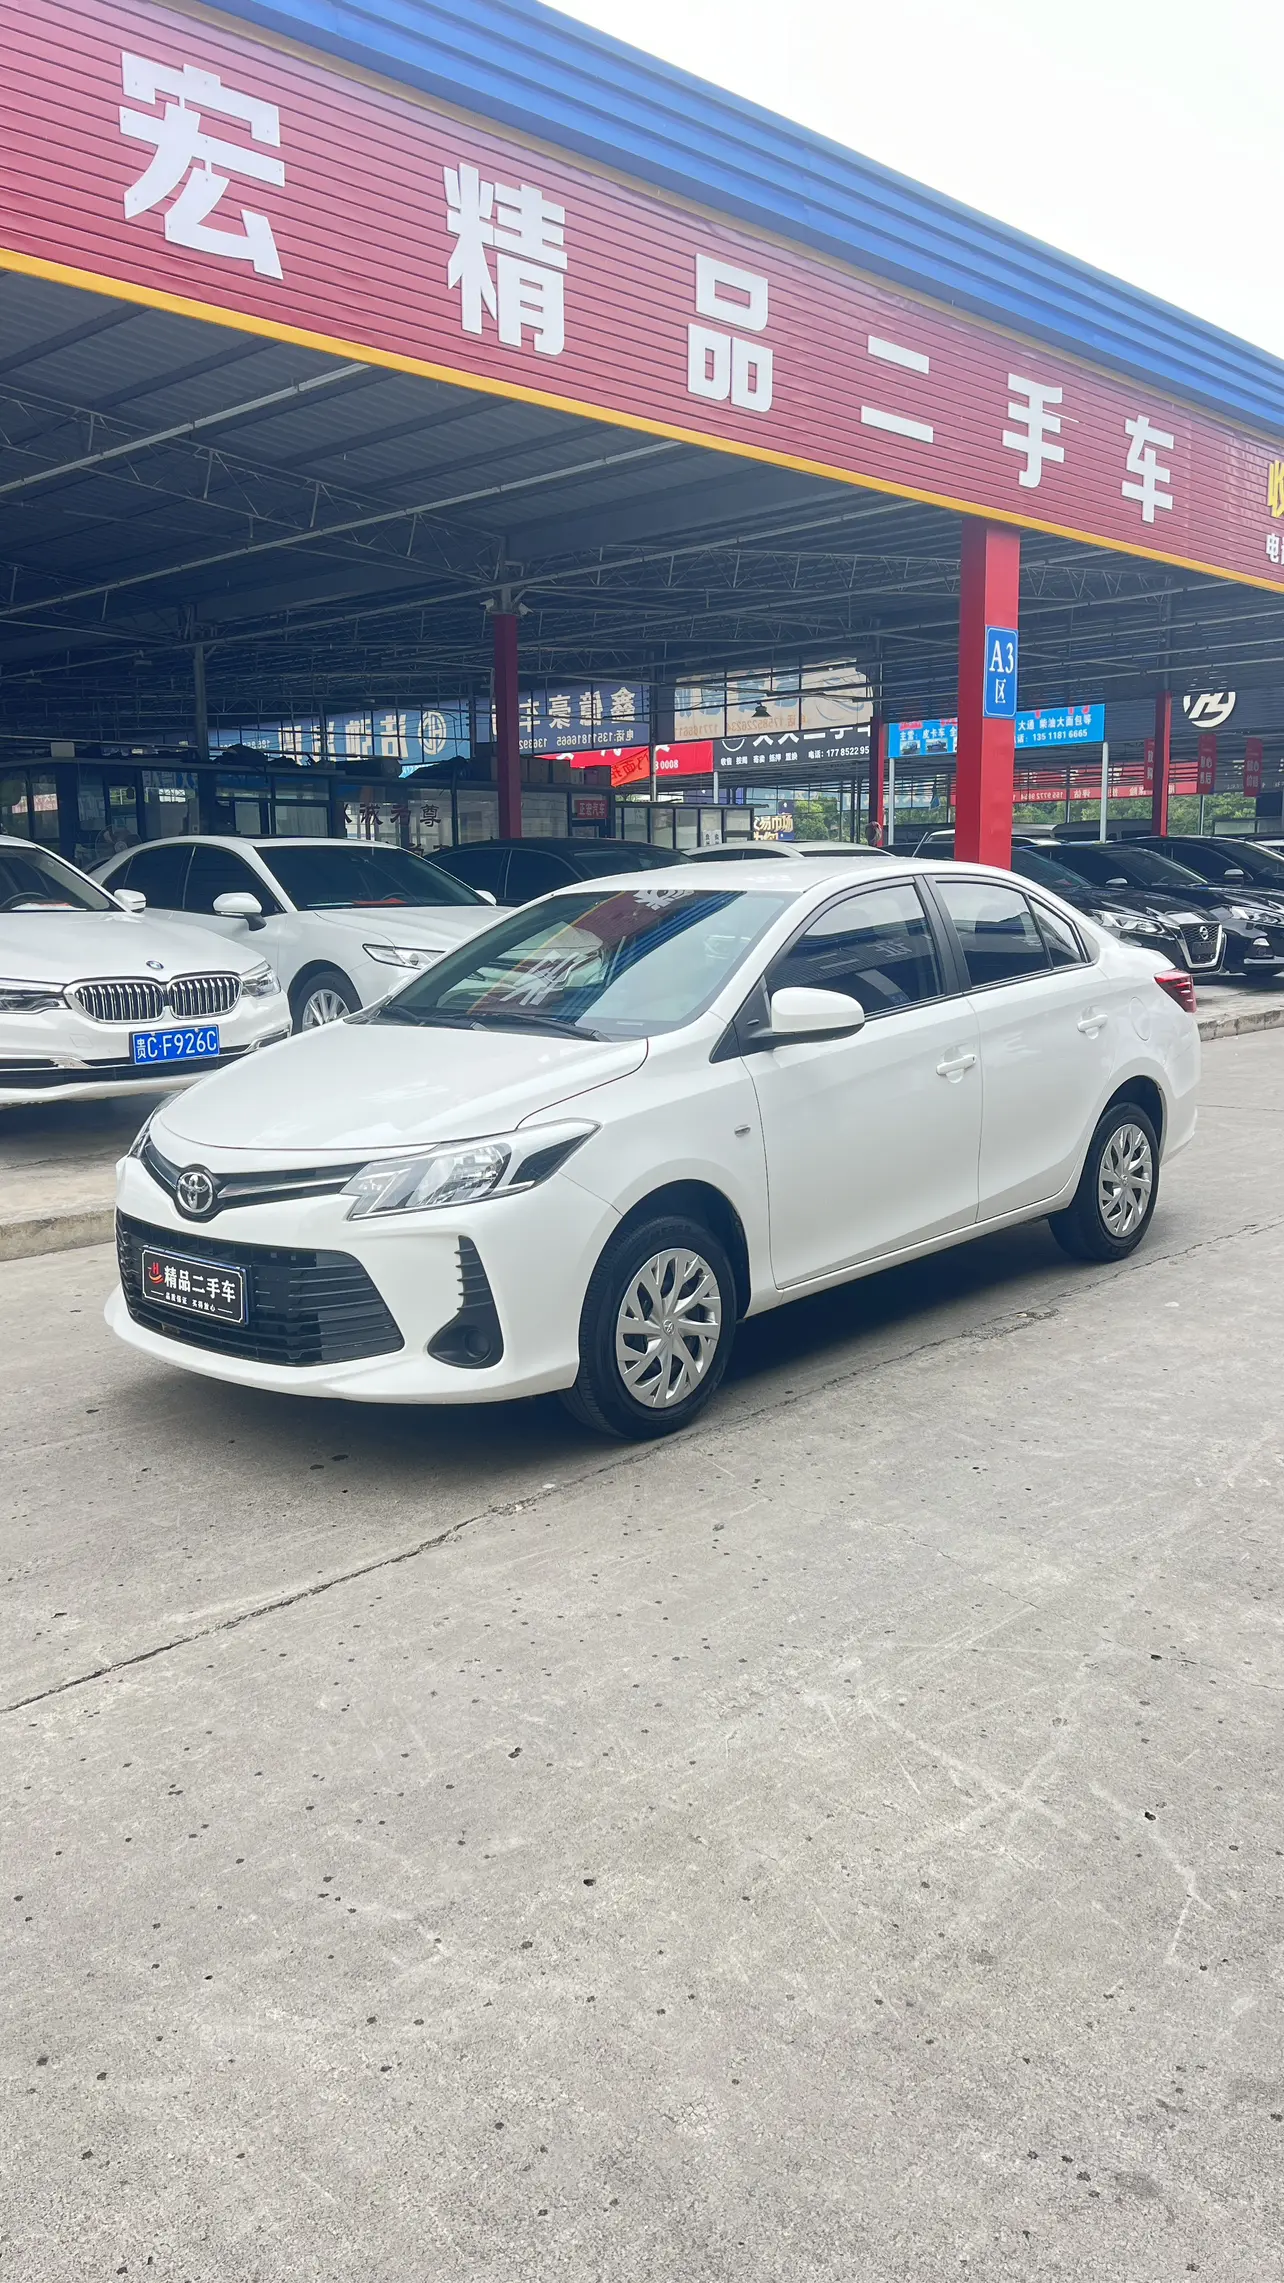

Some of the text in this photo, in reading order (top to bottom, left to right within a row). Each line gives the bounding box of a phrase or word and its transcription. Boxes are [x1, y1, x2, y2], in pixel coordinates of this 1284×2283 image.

[119, 52, 1175, 523] 宏精品二手车
[1266, 533, 1284, 565] 电
[989, 640, 1014, 674] A3
[994, 678, 1007, 704] 区
[922, 727, 945, 739] 皮卡车
[1018, 720, 1035, 731] 大通
[1039, 714, 1092, 730] 柴油大面包等
[1014, 728, 1088, 745] 话： 135 1181 6665
[826, 749, 839, 757] 177
[840, 747, 859, 756] 8522
[164, 1265, 236, 1303] 精品二手车
